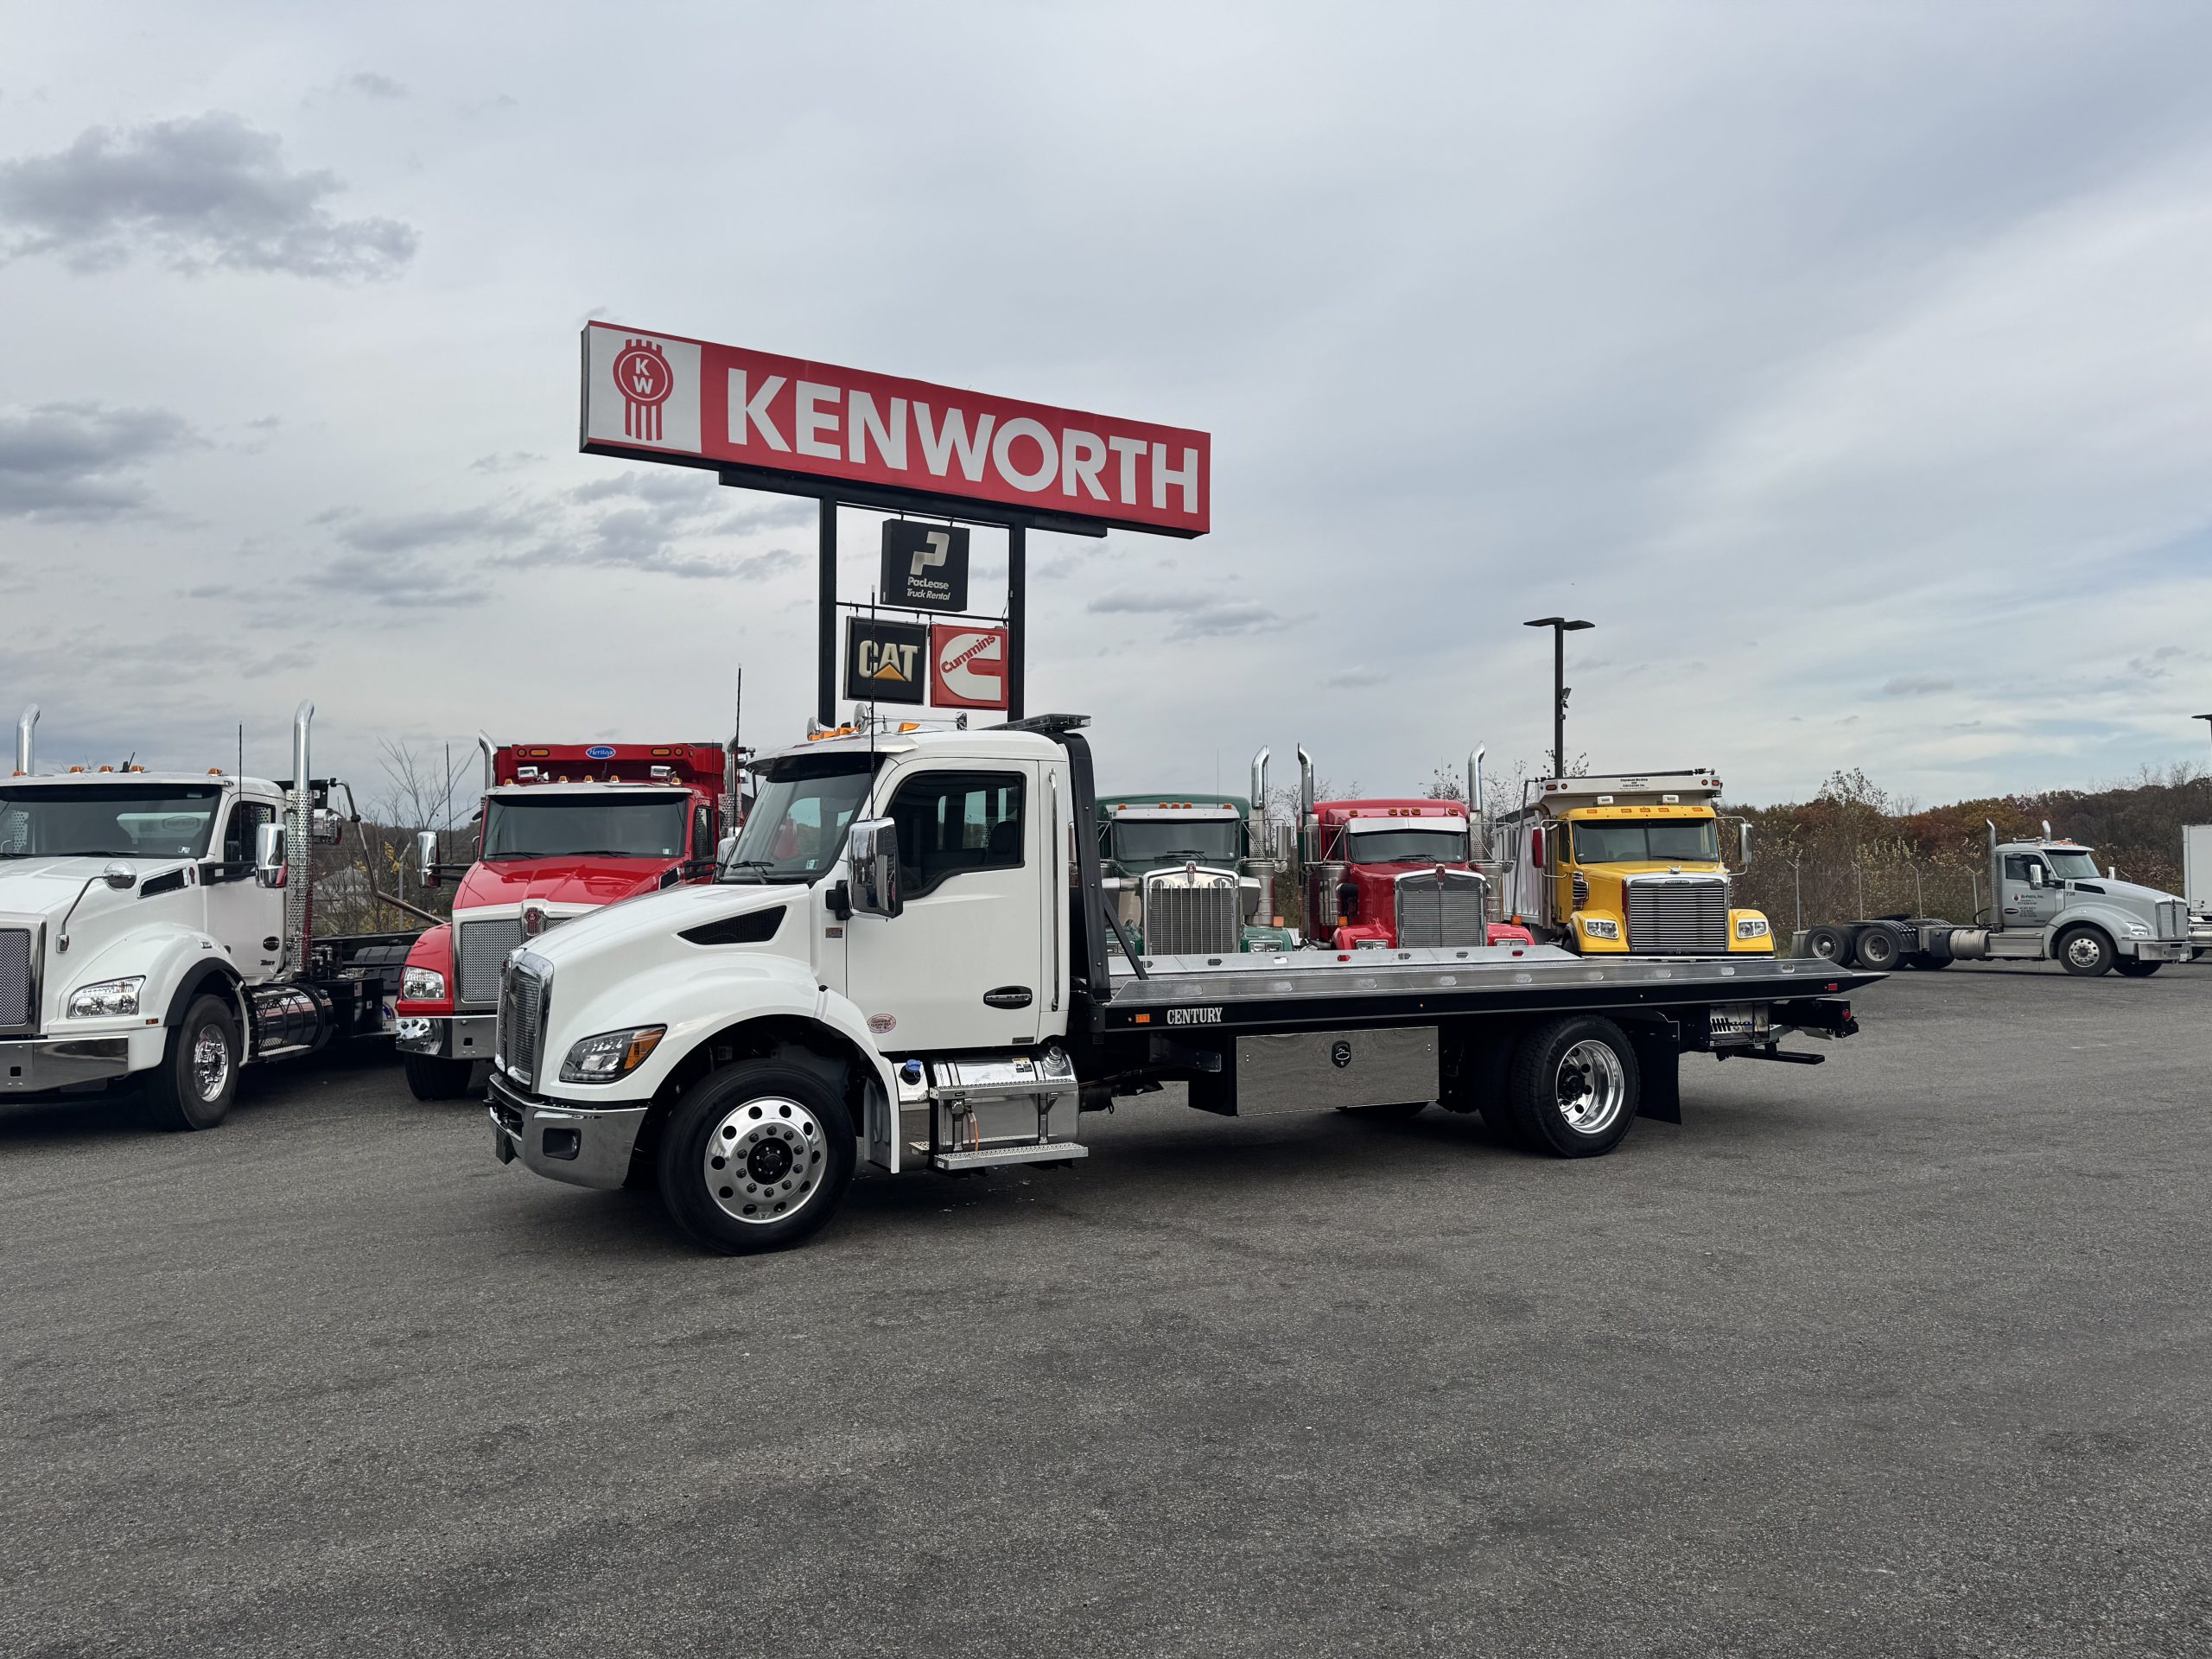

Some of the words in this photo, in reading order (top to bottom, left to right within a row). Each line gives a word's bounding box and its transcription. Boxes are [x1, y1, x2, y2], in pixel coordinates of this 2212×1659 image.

[636, 357, 651, 376] K
[632, 375, 654, 395] W
[728, 367, 1198, 514] KENWORTH
[907, 576, 950, 590] PacLease
[906, 588, 925, 598] Truck
[926, 590, 951, 601] Rental
[858, 639, 919, 683] CAT
[941, 634, 996, 674] Cummins
[1166, 1007, 1223, 1025] CENTURY
